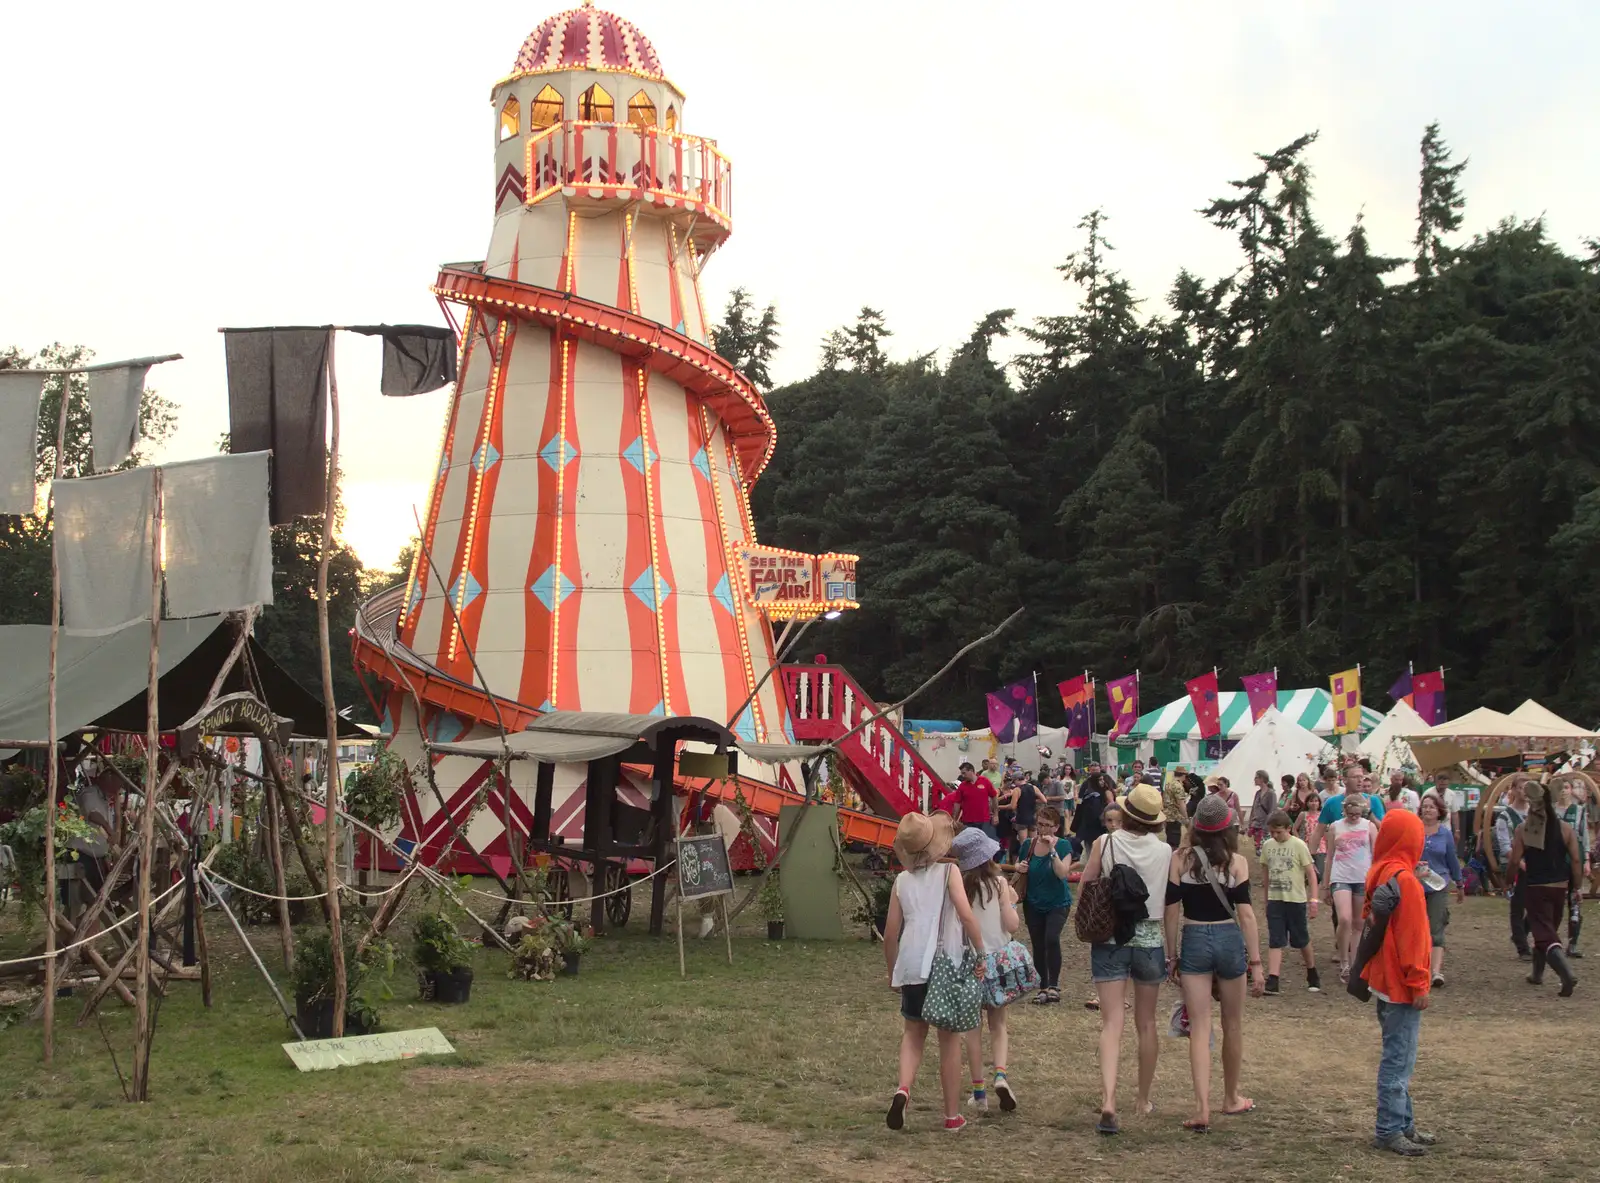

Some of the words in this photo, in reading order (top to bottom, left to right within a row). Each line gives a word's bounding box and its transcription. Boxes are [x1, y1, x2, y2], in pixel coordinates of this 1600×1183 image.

[749, 556, 776, 568] SEE
[779, 556, 804, 568] THE
[833, 559, 856, 573] AL
[749, 569, 797, 594] FAIR
[844, 573, 856, 582] FO
[775, 581, 811, 601] AIR!
[825, 582, 856, 601] FU
[198, 702, 238, 738] SPINNEY
[240, 699, 274, 736] HOLLOW
[1267, 847, 1295, 857] BRAZIL
